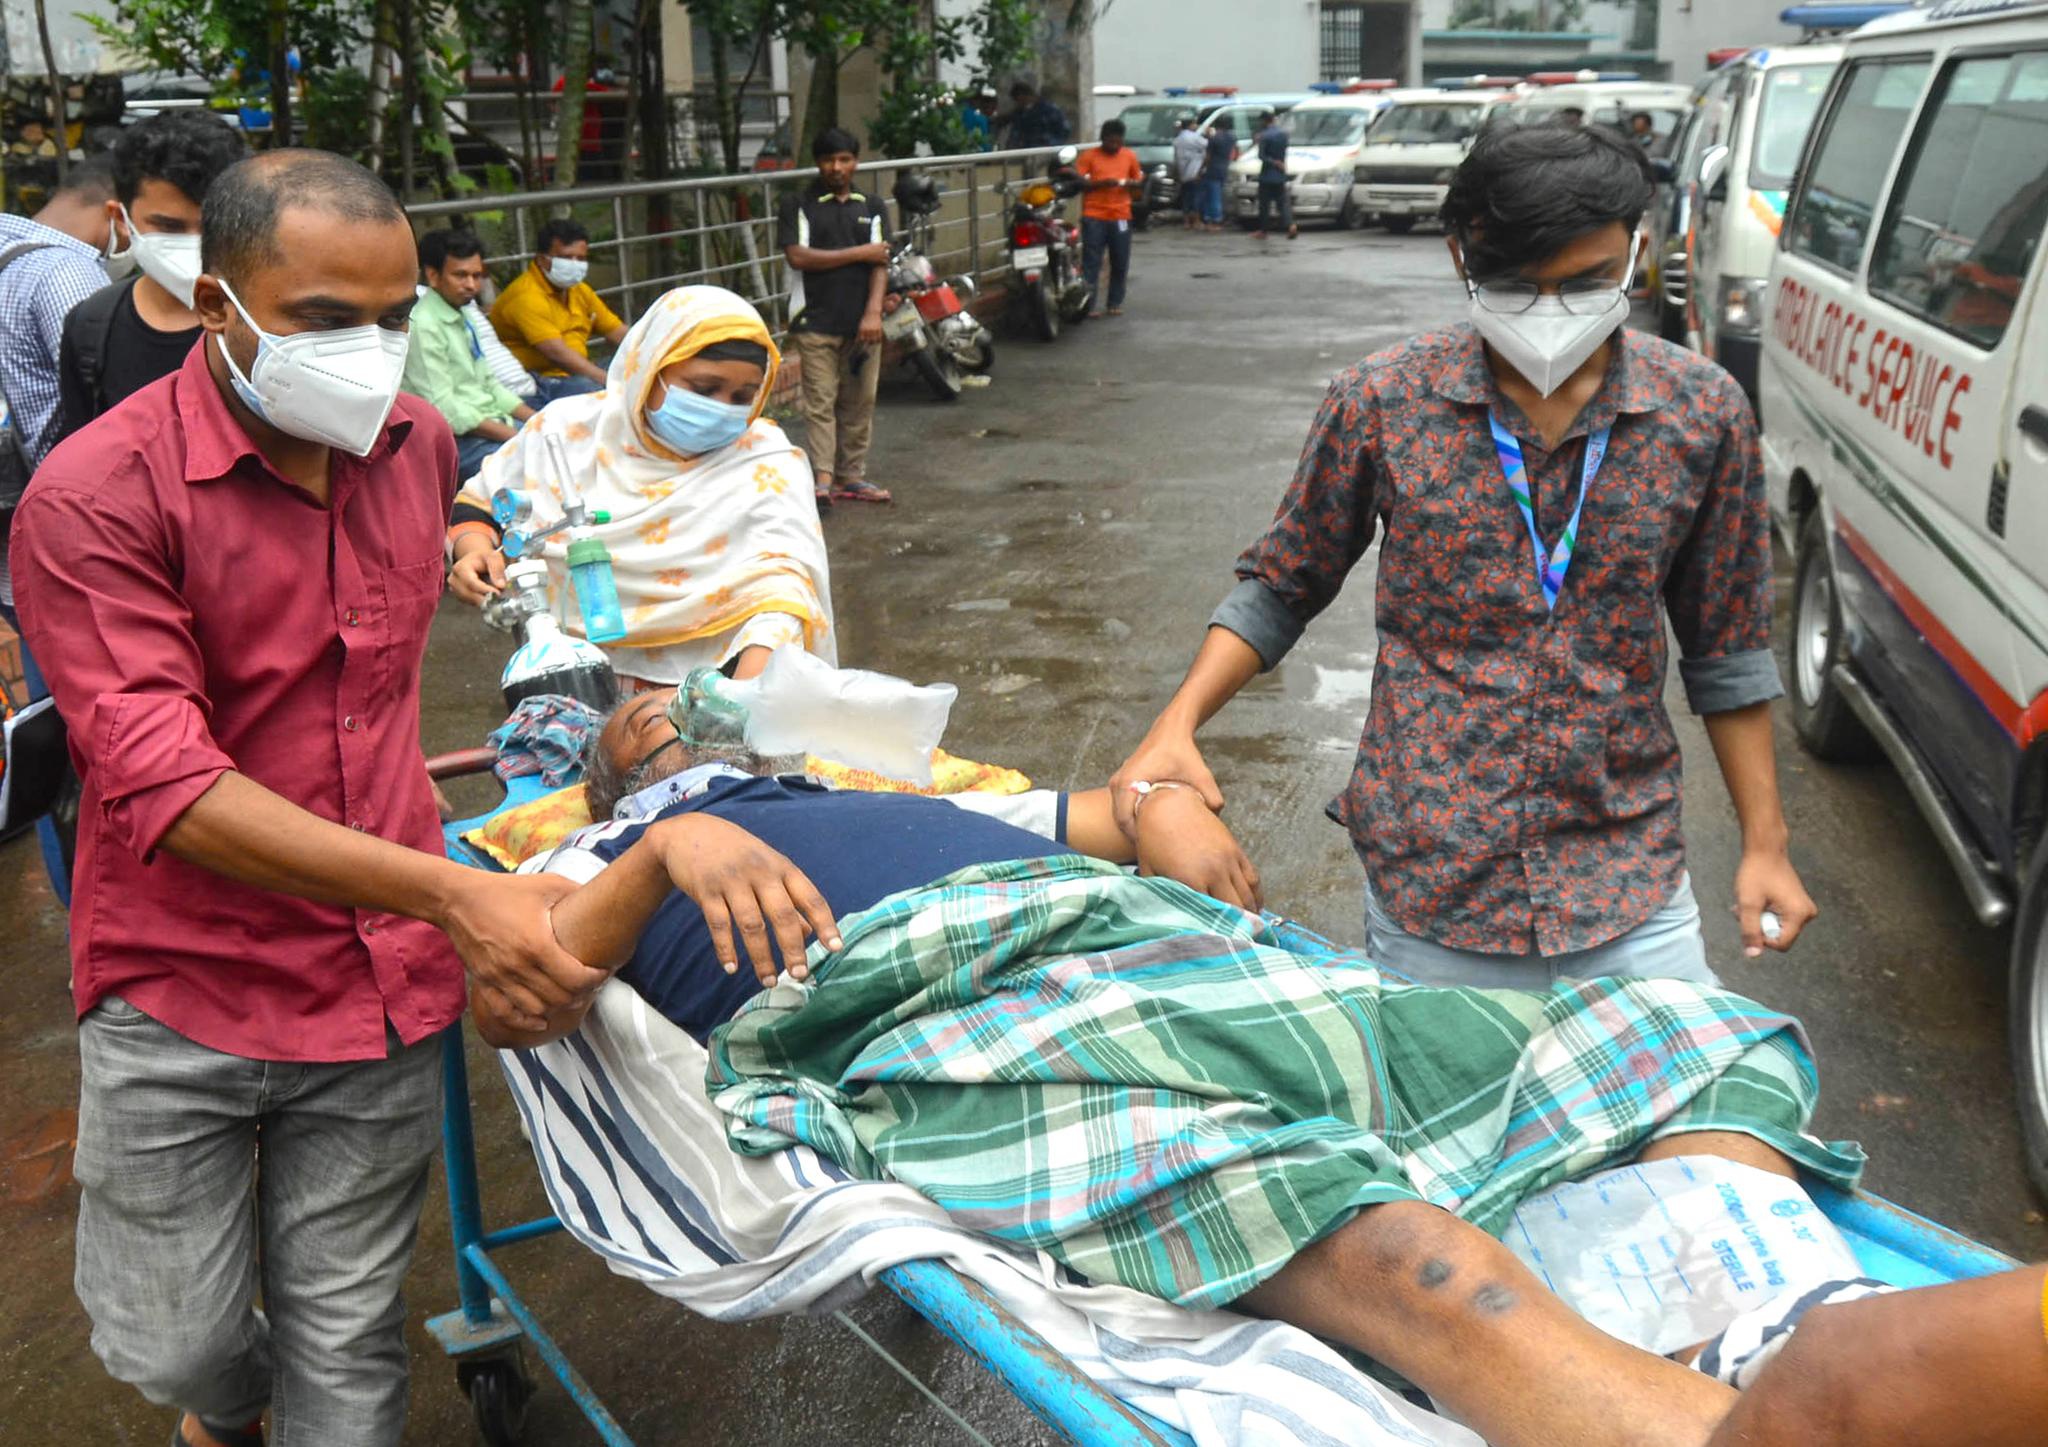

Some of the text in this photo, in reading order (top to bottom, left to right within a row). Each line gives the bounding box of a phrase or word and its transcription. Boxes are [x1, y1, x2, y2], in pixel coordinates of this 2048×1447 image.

[1774, 276, 1974, 470] AMBULANCE SERVICE
[1711, 1239, 1756, 1292] STERILE
[1741, 1223, 1769, 1258] Urine
[1762, 1259, 1786, 1286] bag
